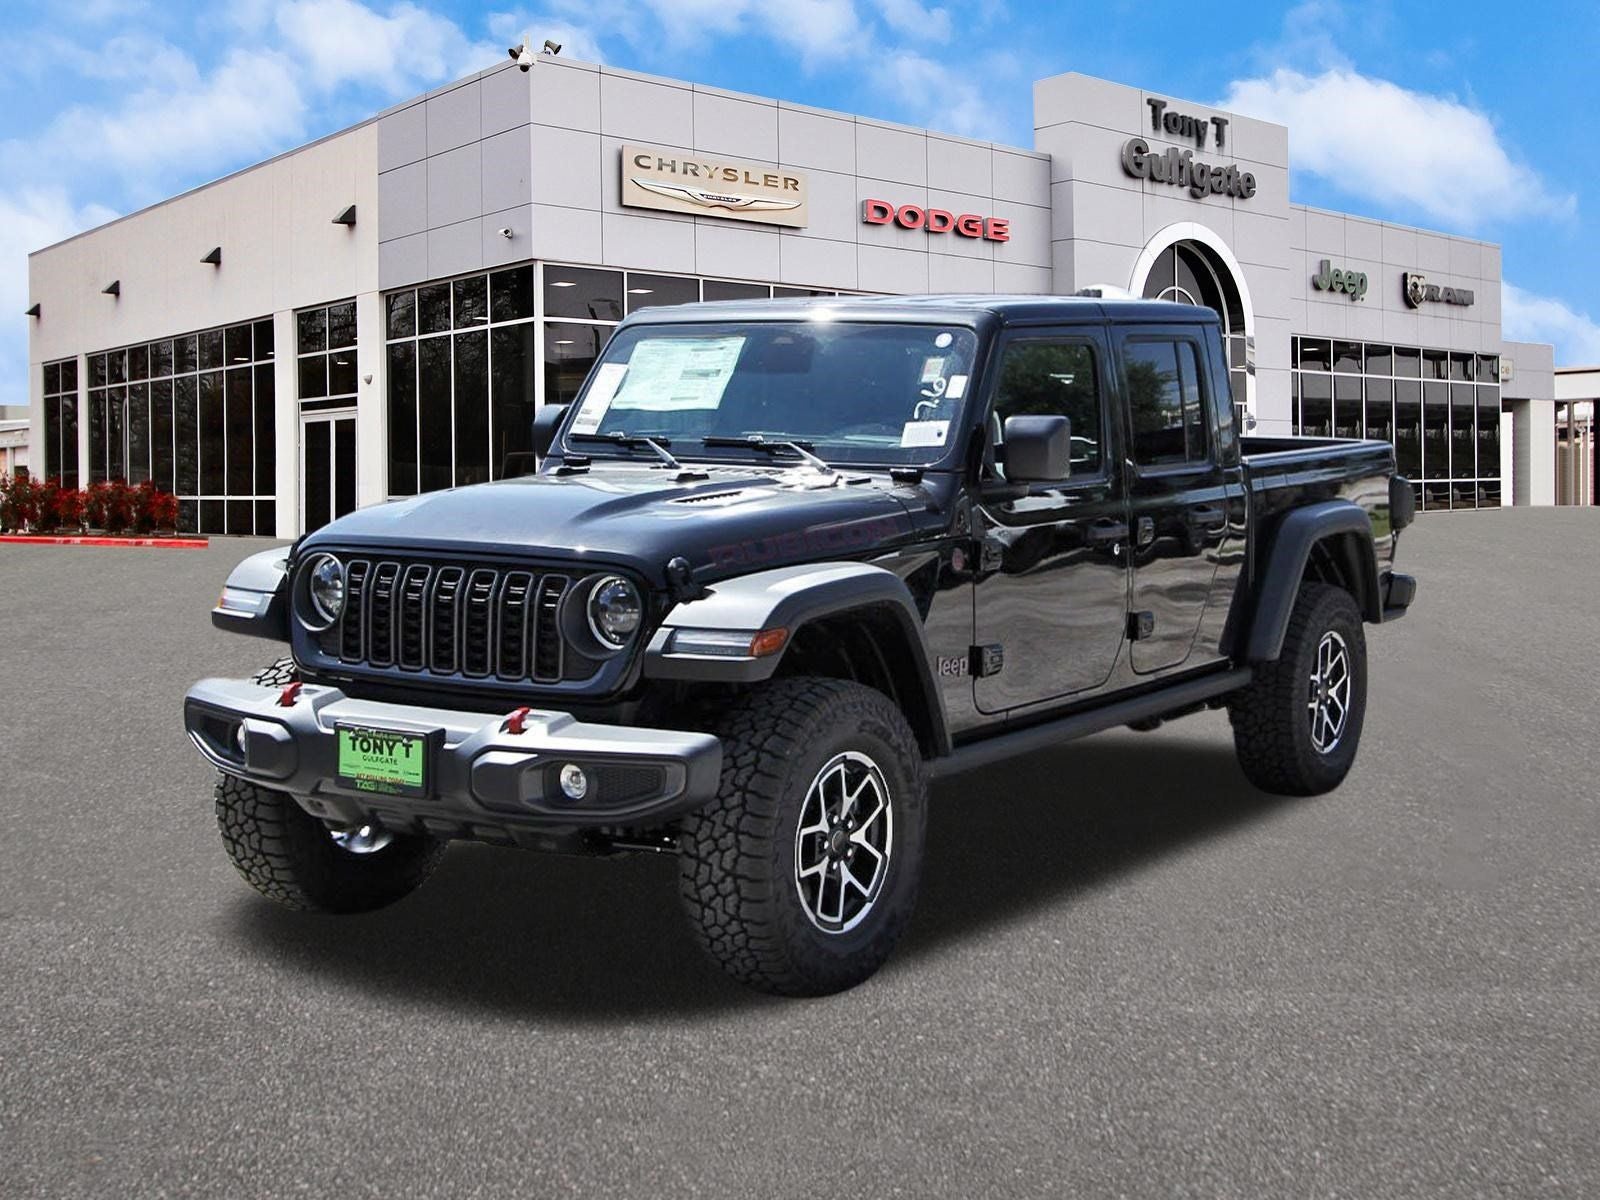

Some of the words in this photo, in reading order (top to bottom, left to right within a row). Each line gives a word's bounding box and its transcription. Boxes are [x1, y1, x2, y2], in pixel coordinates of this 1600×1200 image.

[1147, 98, 1208, 147] Tony
[1211, 116, 1229, 147] T
[633, 154, 800, 192] CHRYSLER
[1121, 138, 1256, 199] Gulfgate
[863, 198, 1010, 242] DODGE
[1313, 259, 1368, 301] Jeep
[1424, 284, 1475, 307] RAM
[349, 736, 397, 756] TONY
[402, 742, 413, 759] T
